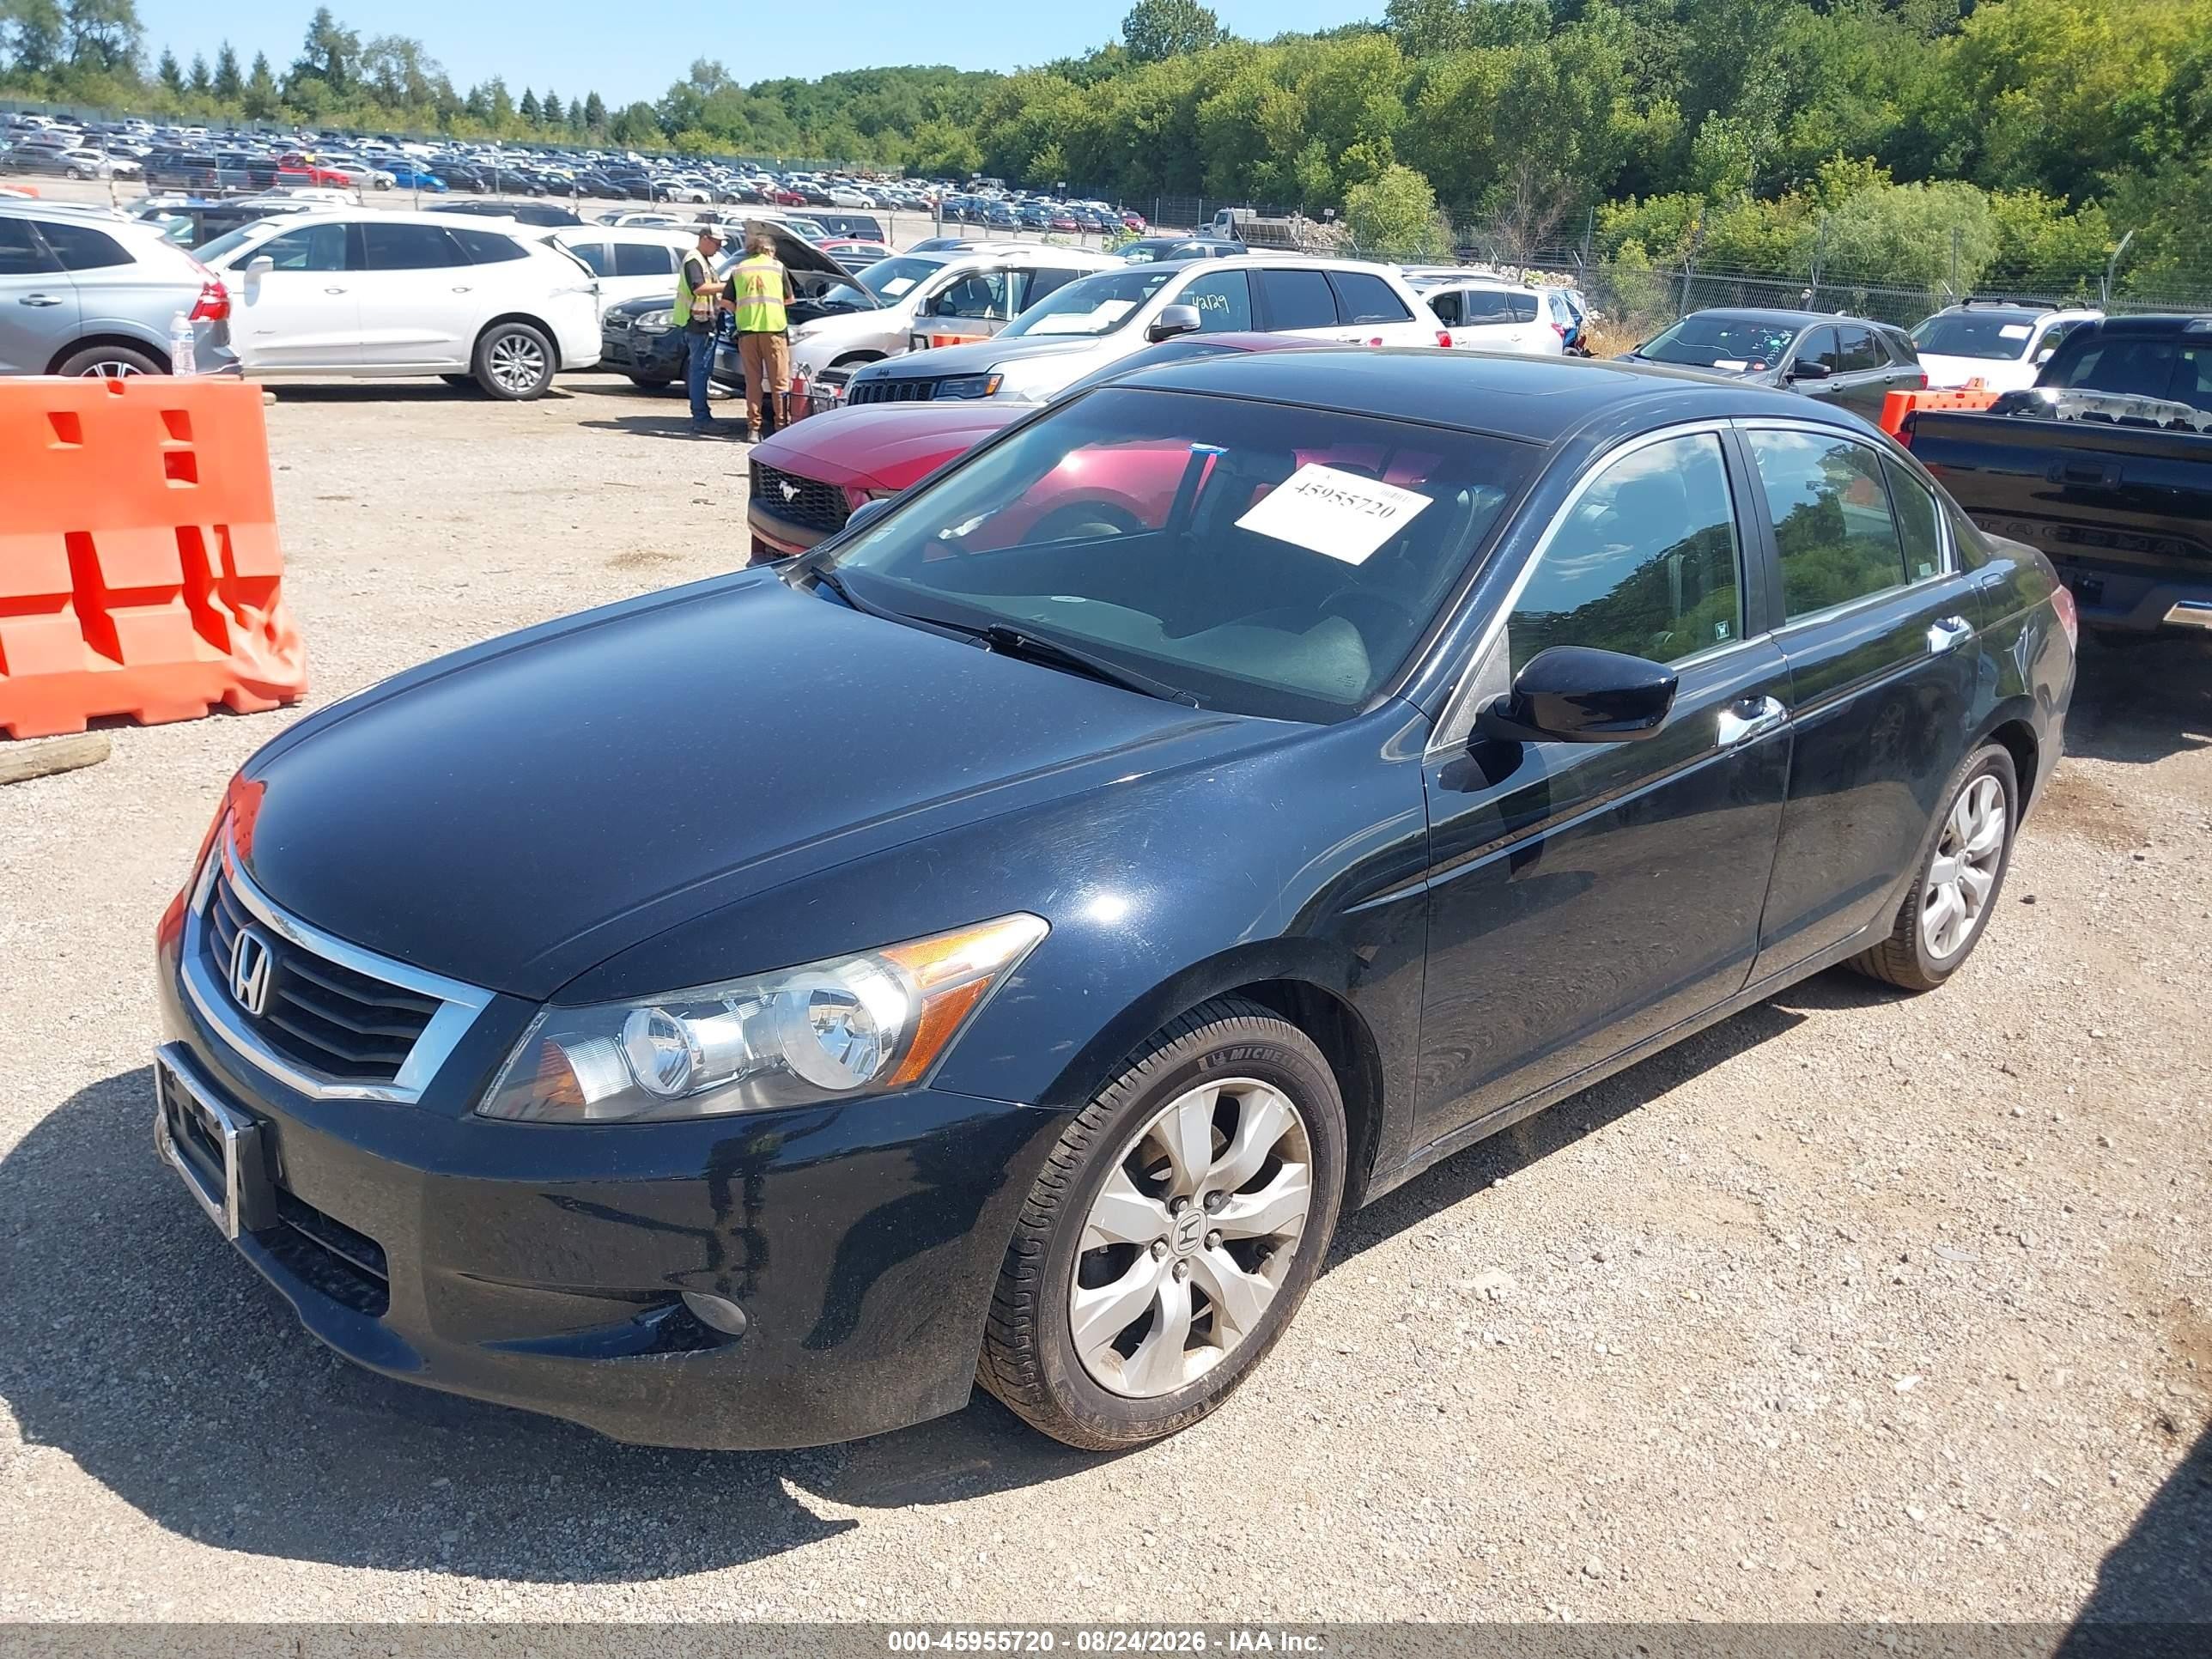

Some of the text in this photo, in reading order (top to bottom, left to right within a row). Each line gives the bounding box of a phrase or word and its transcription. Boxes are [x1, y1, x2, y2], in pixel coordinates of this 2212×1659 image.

[1192, 294, 1230, 313] 42129
[1974, 377, 1979, 387] 2
[1295, 482, 1397, 519] 45955720
[1229, 1046, 1307, 1075] MICHELIN
